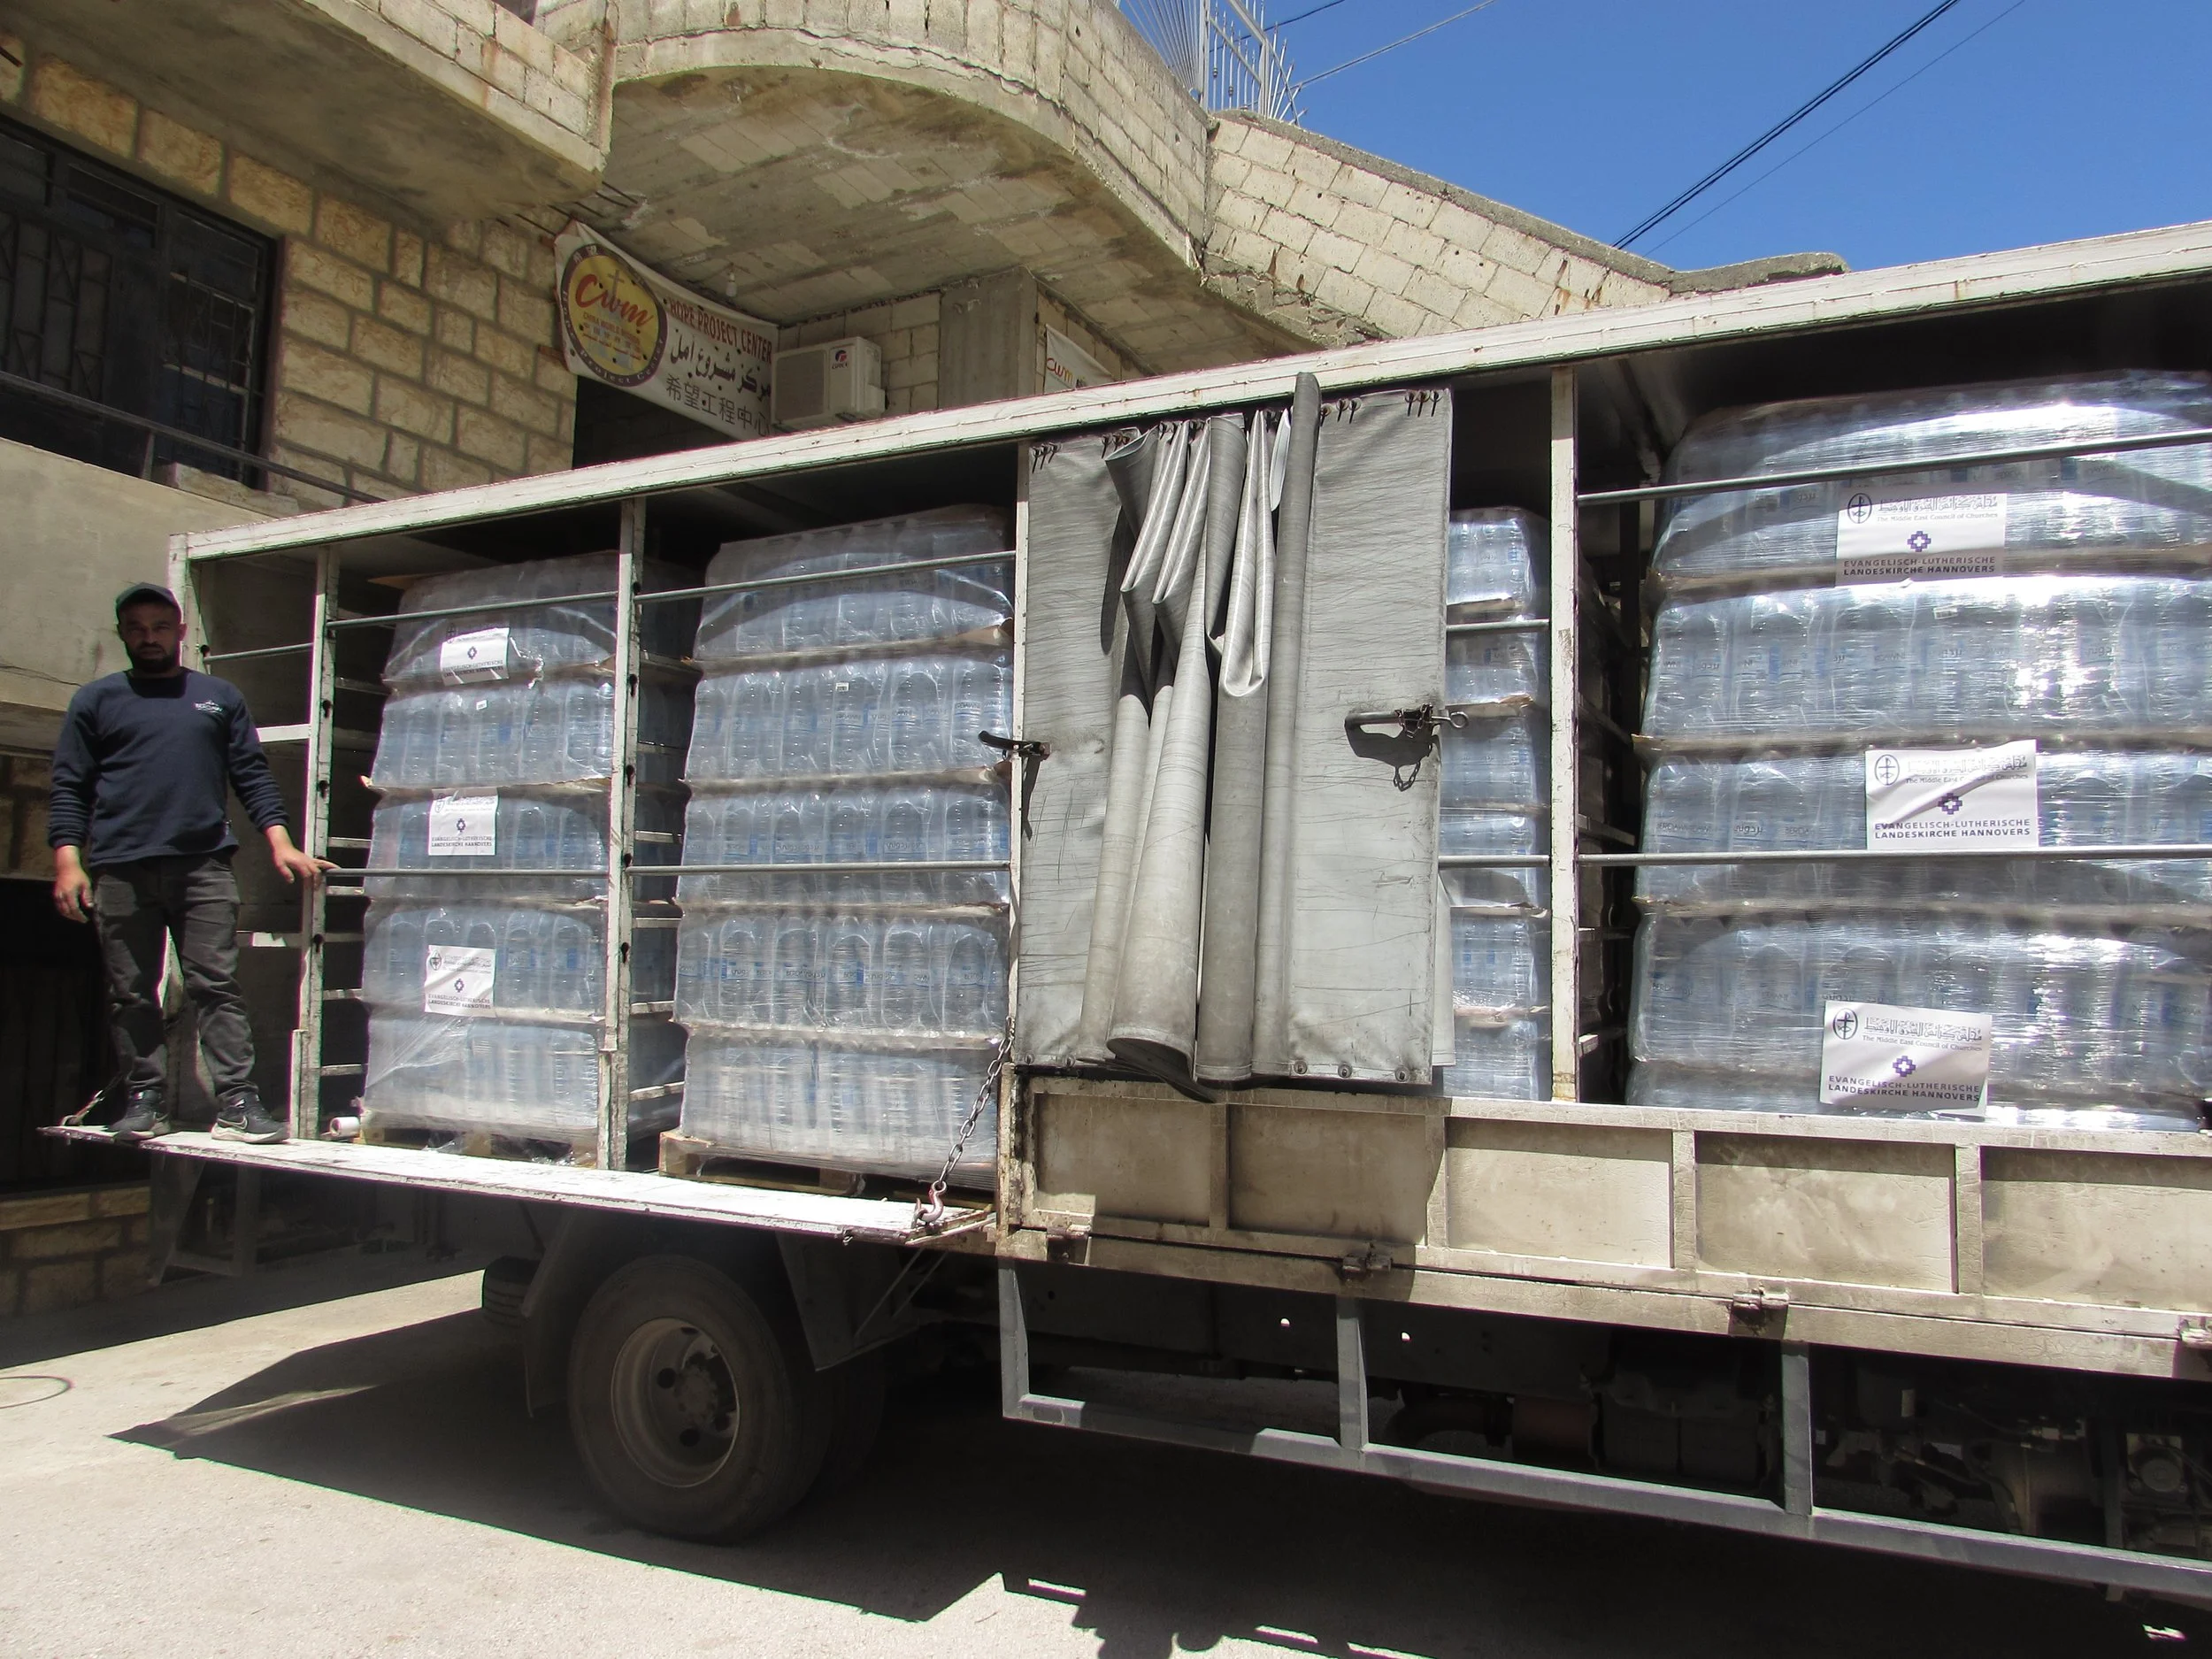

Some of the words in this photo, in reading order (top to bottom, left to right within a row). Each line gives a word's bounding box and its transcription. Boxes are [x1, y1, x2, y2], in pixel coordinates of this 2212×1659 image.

[669, 299, 695, 328] HOPE
[697, 311, 738, 347] PROJECT
[741, 328, 772, 365] CENTER
[1844, 556, 1996, 568] EVANGELISCH-LUTHERISCHE
[1844, 565, 1923, 576] LANDESKIRCHE
[1927, 565, 1995, 573] HANNOVERS
[1874, 818, 2031, 830] EVANGELISCH-LUTHERISCHE
[1875, 829, 1957, 839] LANDESKIRCHE
[1961, 827, 2031, 837] HANNOVERS
[1829, 1075, 1980, 1094] EVANGELISCH-LUTHERISCHE
[1828, 1084, 1909, 1097] LANDESKIRCHE
[1912, 1090, 1980, 1102] HANNOVERS
